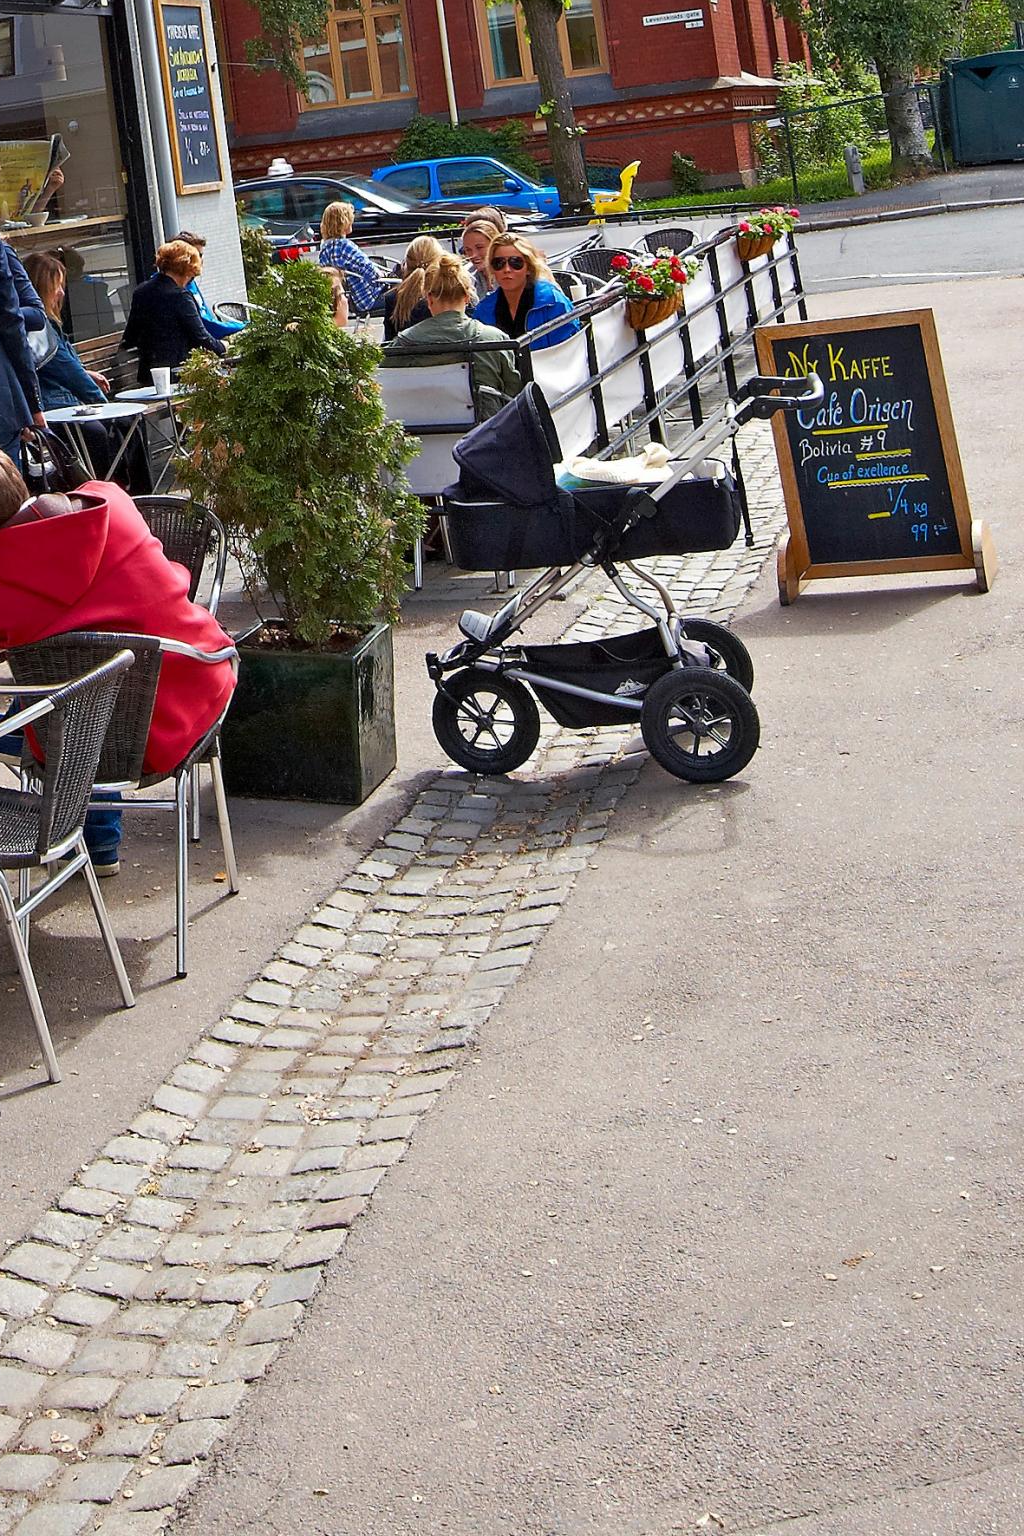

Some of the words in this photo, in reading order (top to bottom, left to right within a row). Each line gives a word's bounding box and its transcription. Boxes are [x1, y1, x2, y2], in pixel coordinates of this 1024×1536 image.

[828, 343, 894, 382] KAFFE
[797, 391, 843, 430] Café
[850, 387, 915, 432] Origen
[799, 438, 853, 467] Bolivia
[860, 430, 887, 452] #9
[817, 465, 840, 483] Cup
[842, 464, 854, 481] of
[857, 463, 910, 479] exellence
[887, 484, 909, 515] 1/4
